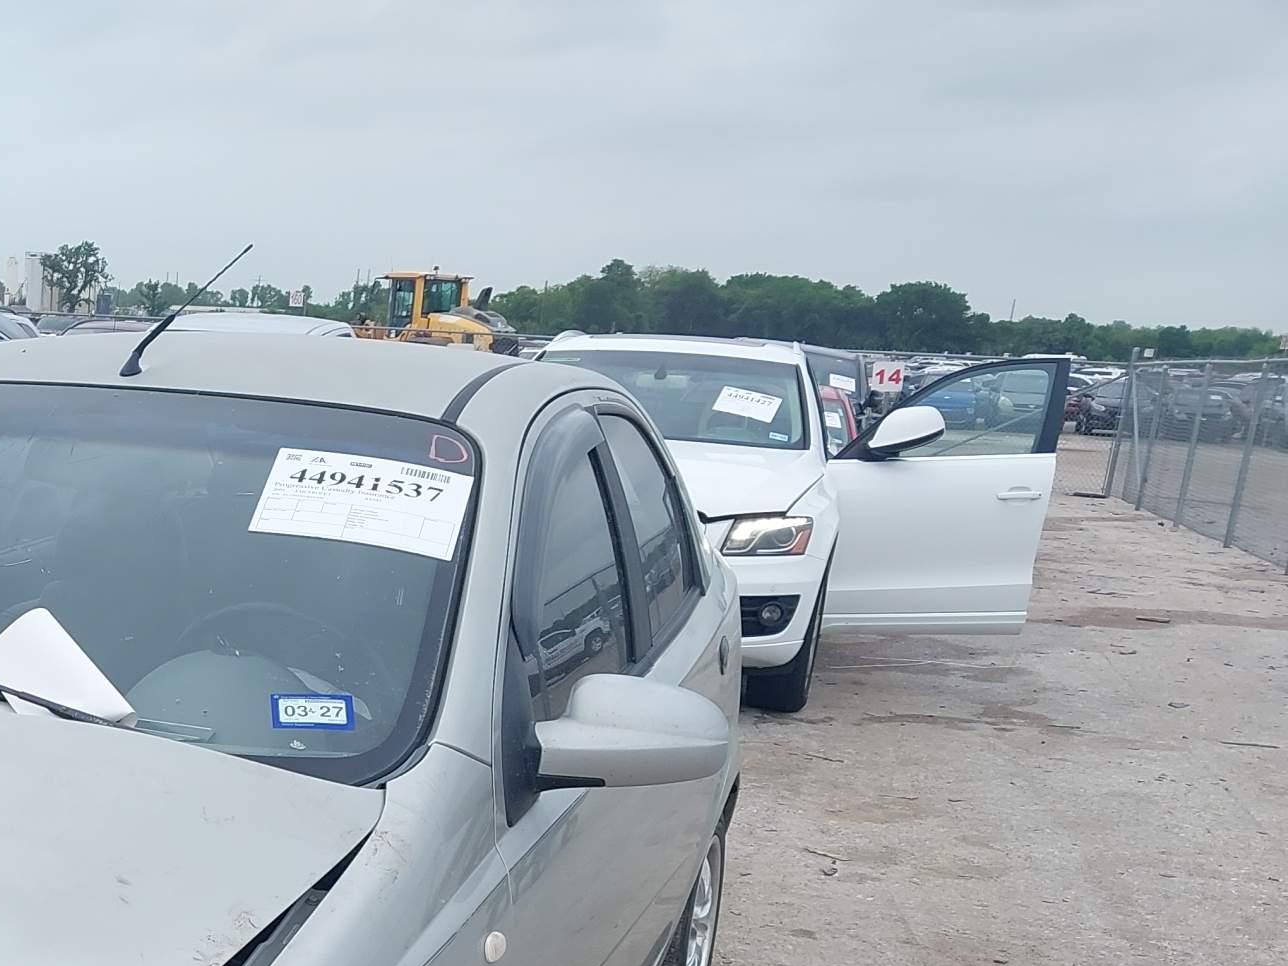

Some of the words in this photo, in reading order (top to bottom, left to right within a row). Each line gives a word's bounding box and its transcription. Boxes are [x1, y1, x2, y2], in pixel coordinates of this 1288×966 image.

[875, 368, 902, 385] 14
[429, 434, 469, 463] D
[289, 468, 444, 502] 44941537
[284, 705, 309, 717] 03
[319, 705, 344, 718] 27
